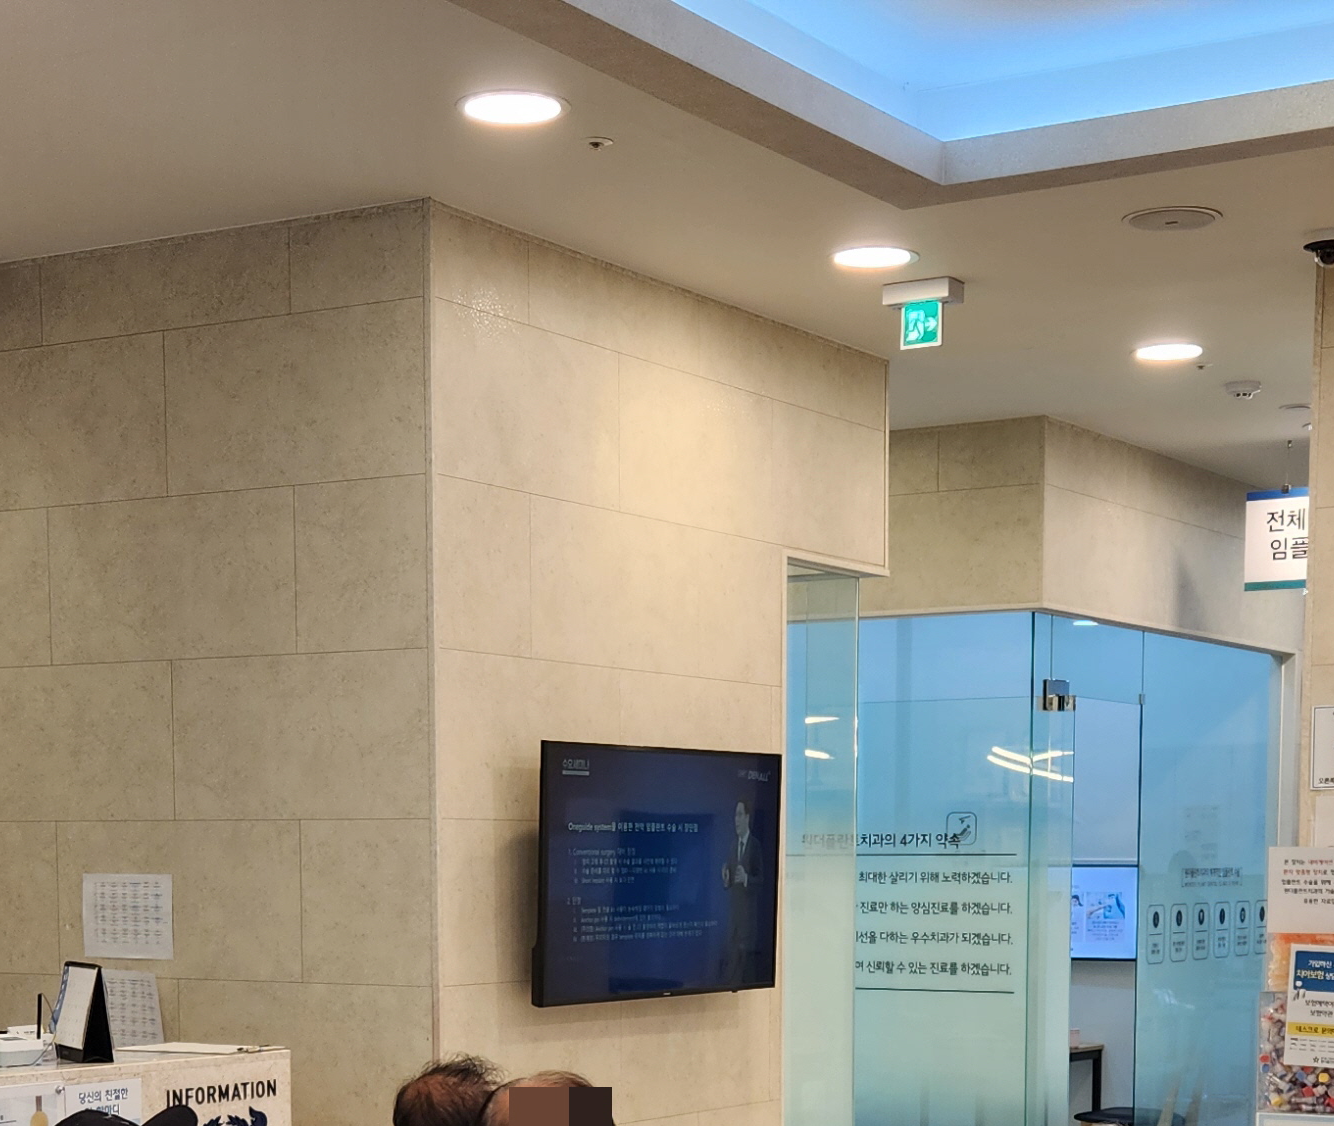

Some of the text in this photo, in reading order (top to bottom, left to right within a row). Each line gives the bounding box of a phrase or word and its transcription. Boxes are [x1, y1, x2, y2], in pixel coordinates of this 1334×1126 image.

[1267, 508, 1305, 532] 전체
[900, 833, 932, 848] 4가지
[936, 834, 961, 849] 약속
[859, 872, 1013, 884] 최대한 살리기 위해 노력하겠습니다.
[860, 901, 1013, 915] 진료만 하는 양심진료를 하겠습니다.
[880, 931, 908, 944] 다하는
[911, 931, 959, 944] 우수치과가
[961, 932, 1013, 945] 되겠습니다.
[866, 962, 1012, 976] 신뢰할 수 있는 진료를 하겠습니다.
[78, 1088, 128, 1105] 당신의 친절한
[167, 1079, 277, 1108] INFORMATION
